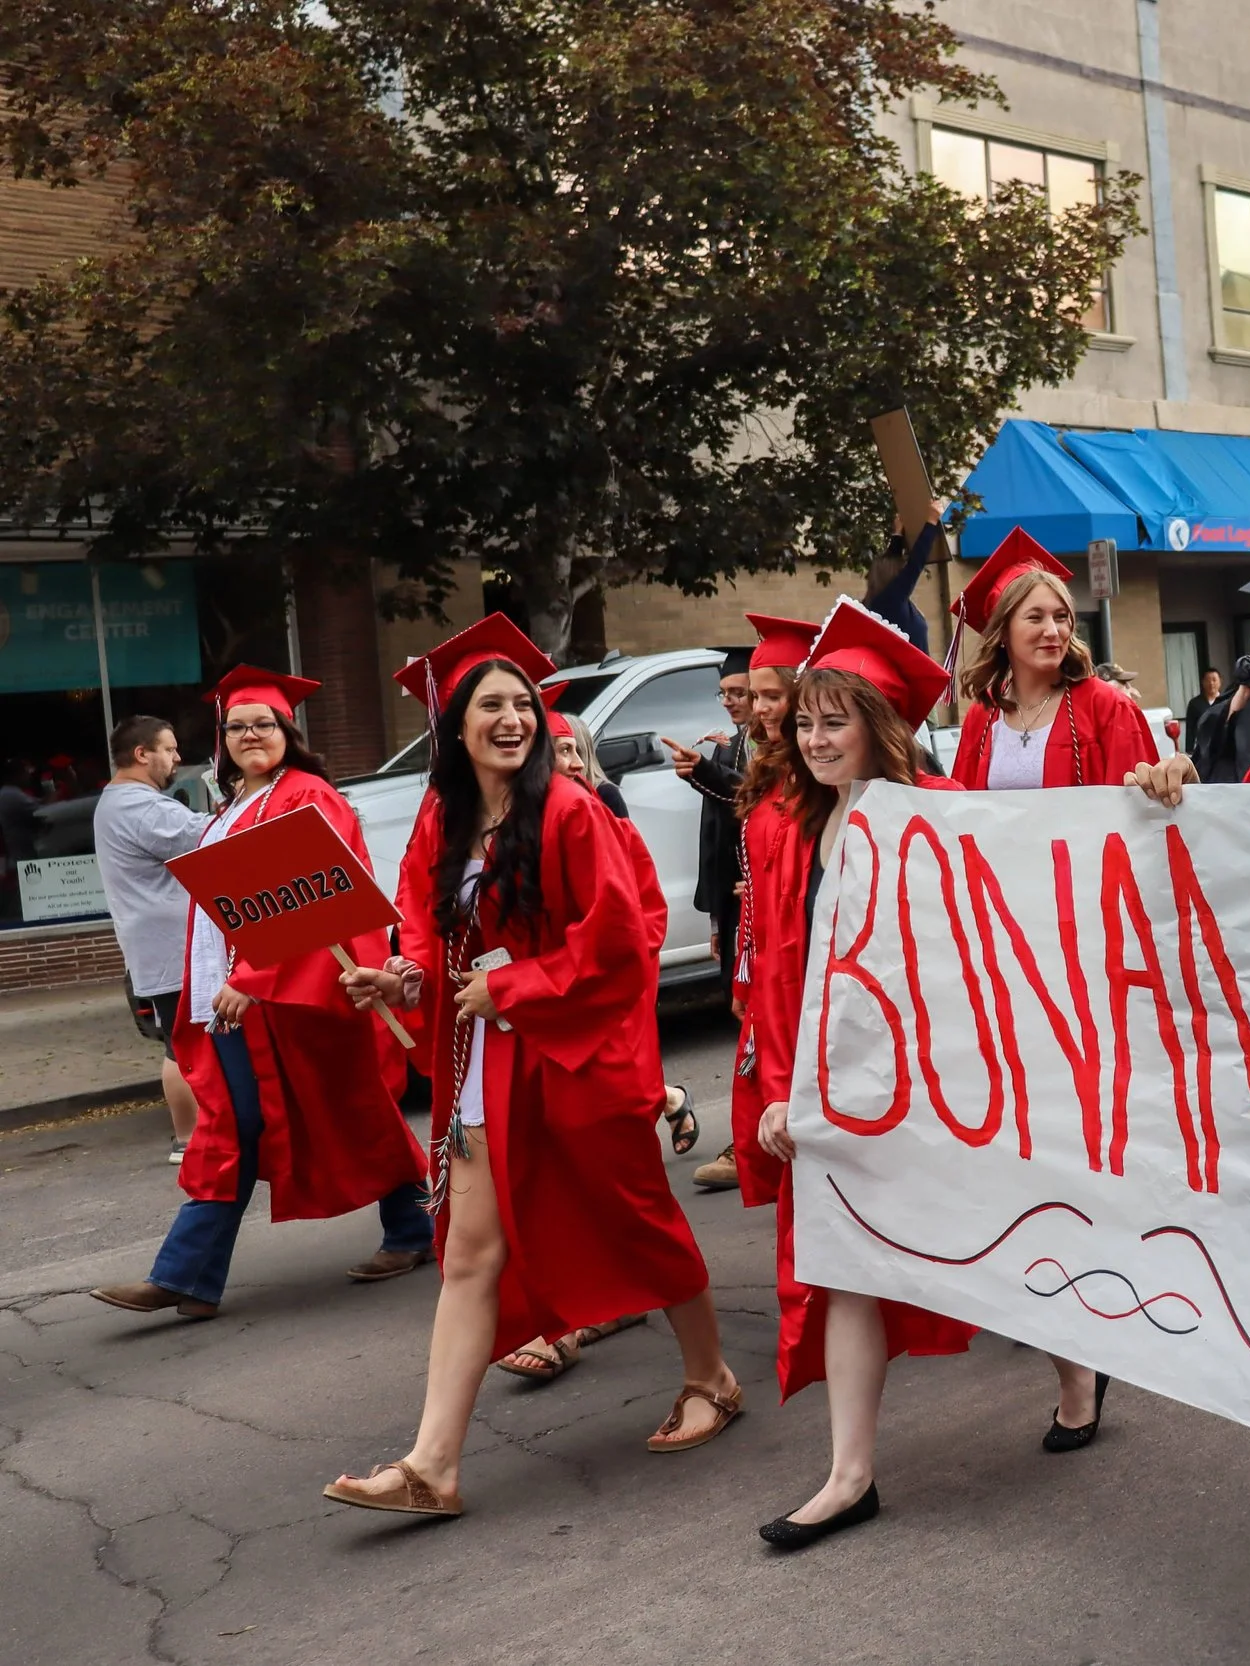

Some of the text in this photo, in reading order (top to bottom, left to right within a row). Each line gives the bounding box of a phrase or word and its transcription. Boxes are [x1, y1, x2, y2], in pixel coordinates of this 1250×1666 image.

[47, 858, 97, 868] Protect
[60, 876, 85, 885] Youth!
[213, 865, 354, 931] Bonanza
